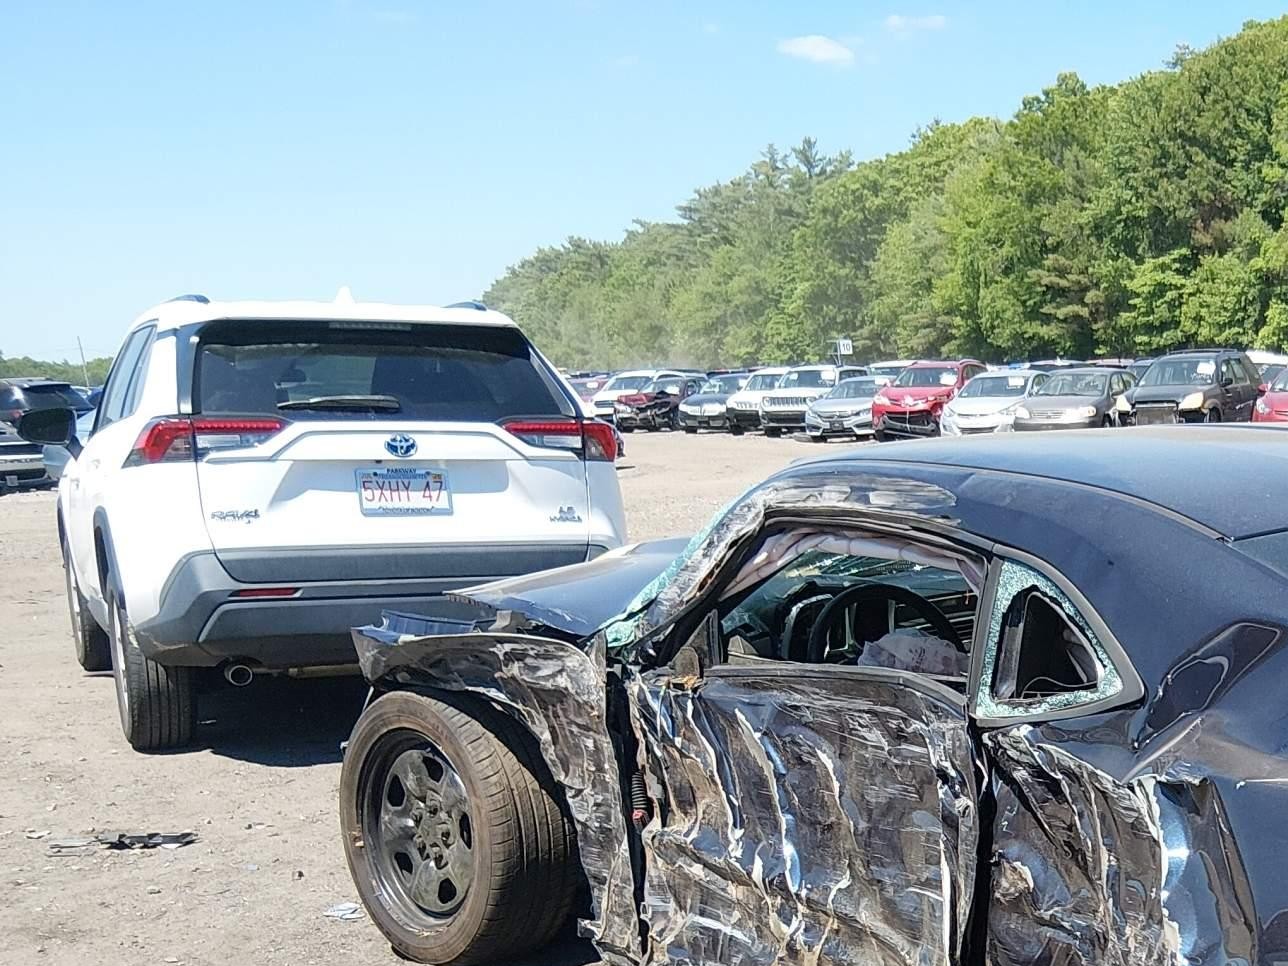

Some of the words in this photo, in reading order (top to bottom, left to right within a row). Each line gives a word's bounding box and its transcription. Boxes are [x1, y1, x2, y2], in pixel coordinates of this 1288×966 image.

[842, 343, 851, 352] 10
[362, 480, 411, 502] 5XHY
[422, 480, 443, 502] 47
